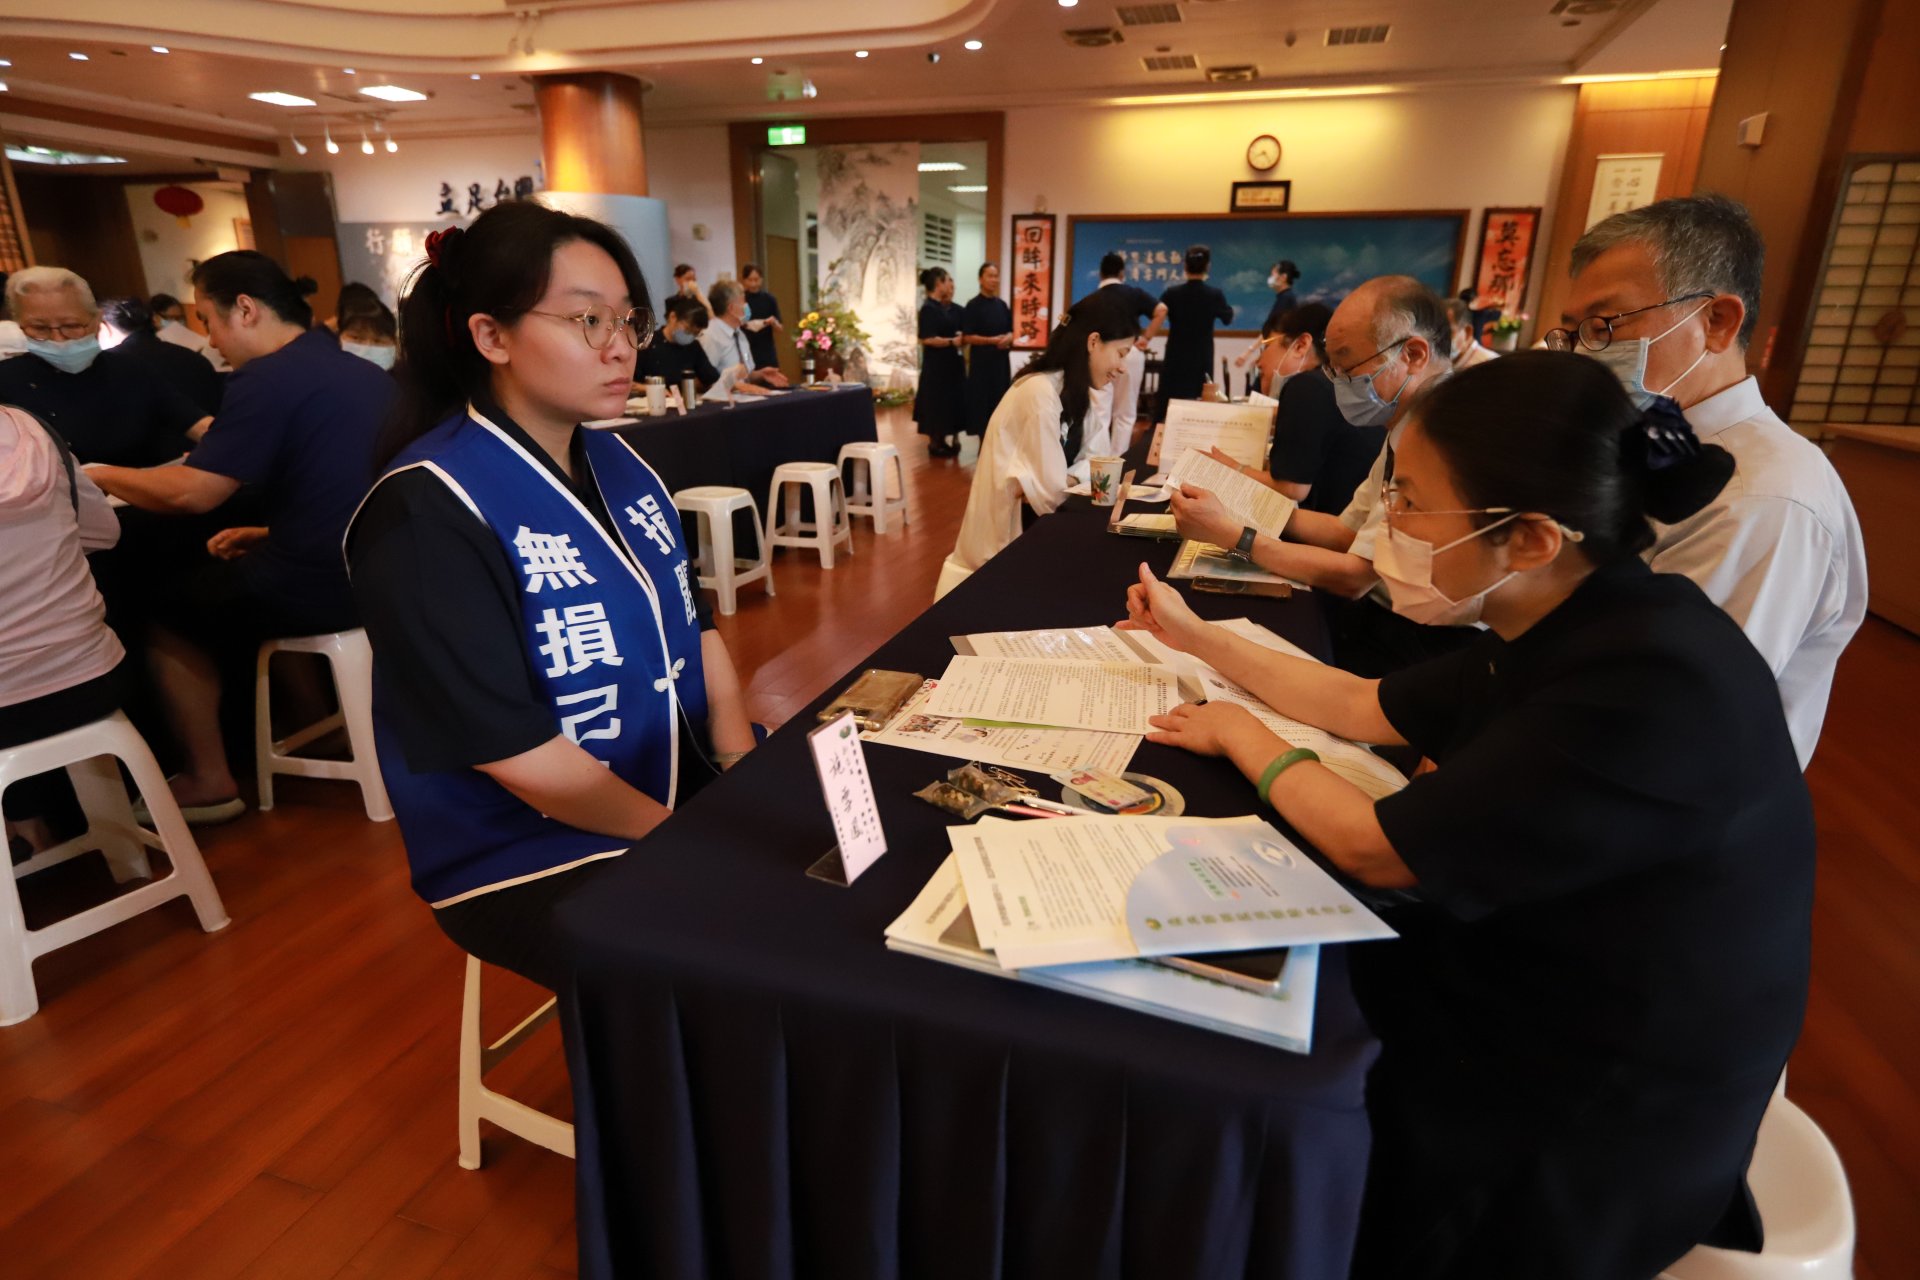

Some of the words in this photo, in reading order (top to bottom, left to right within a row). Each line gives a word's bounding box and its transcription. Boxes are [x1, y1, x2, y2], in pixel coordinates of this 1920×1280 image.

[1020, 225, 1043, 340] 回眸來時路
[512, 524, 625, 771] 無損己
